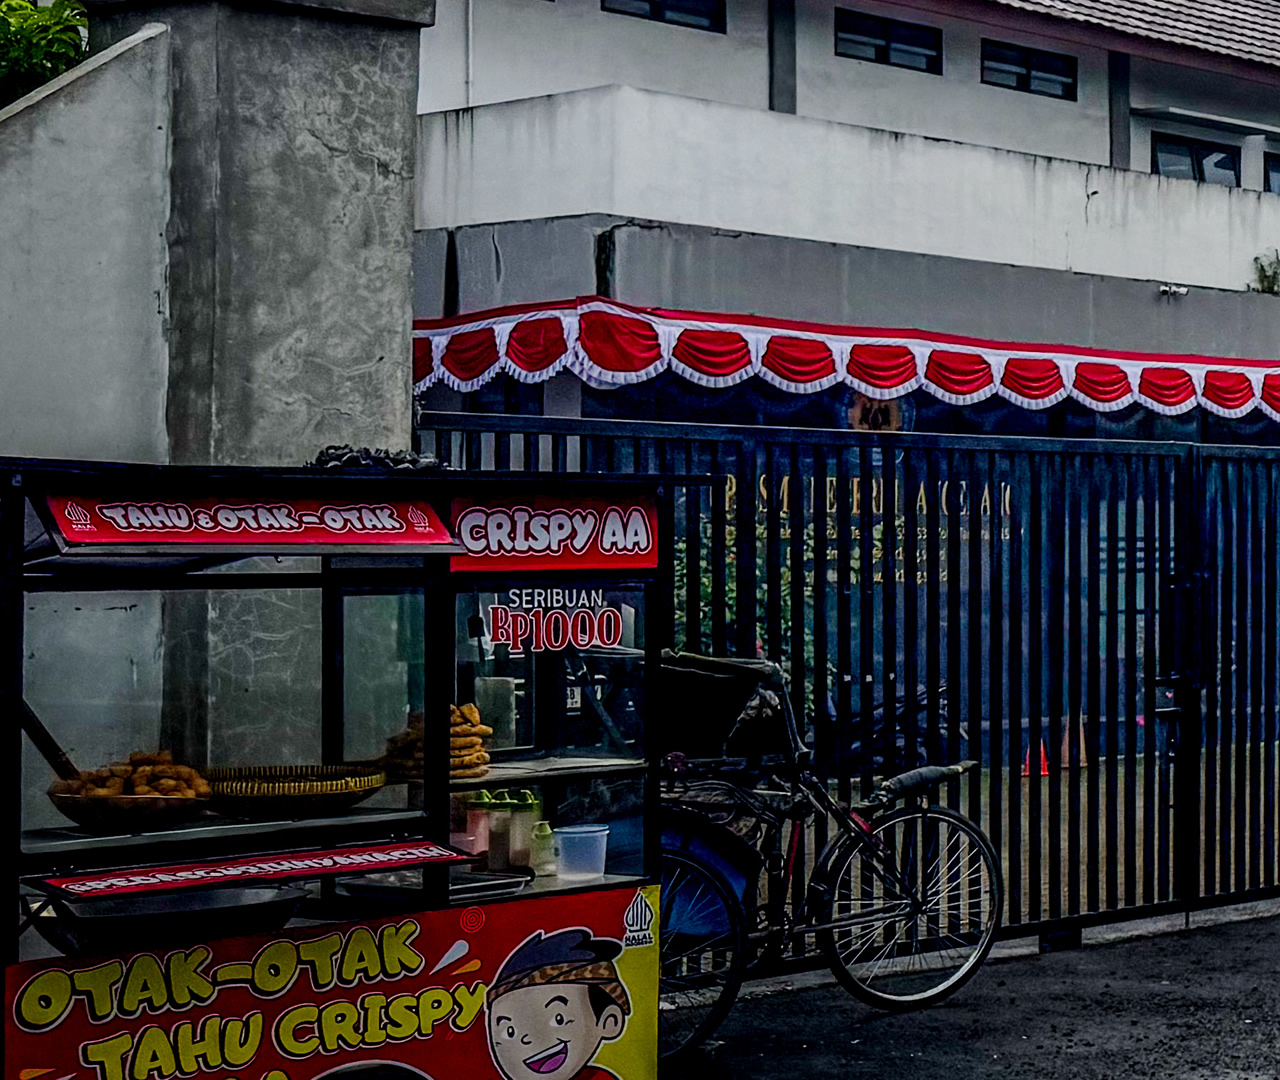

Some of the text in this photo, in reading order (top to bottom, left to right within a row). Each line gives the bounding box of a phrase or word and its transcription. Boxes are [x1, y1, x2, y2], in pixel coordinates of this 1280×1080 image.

[102, 506, 192, 528] TAHU
[460, 510, 648, 552] CRISPY AA
[508, 588, 604, 609] SERIBUAN
[19, 919, 426, 1026] OTAK-OTAK
[86, 982, 488, 1080] TAHU CRISPY
